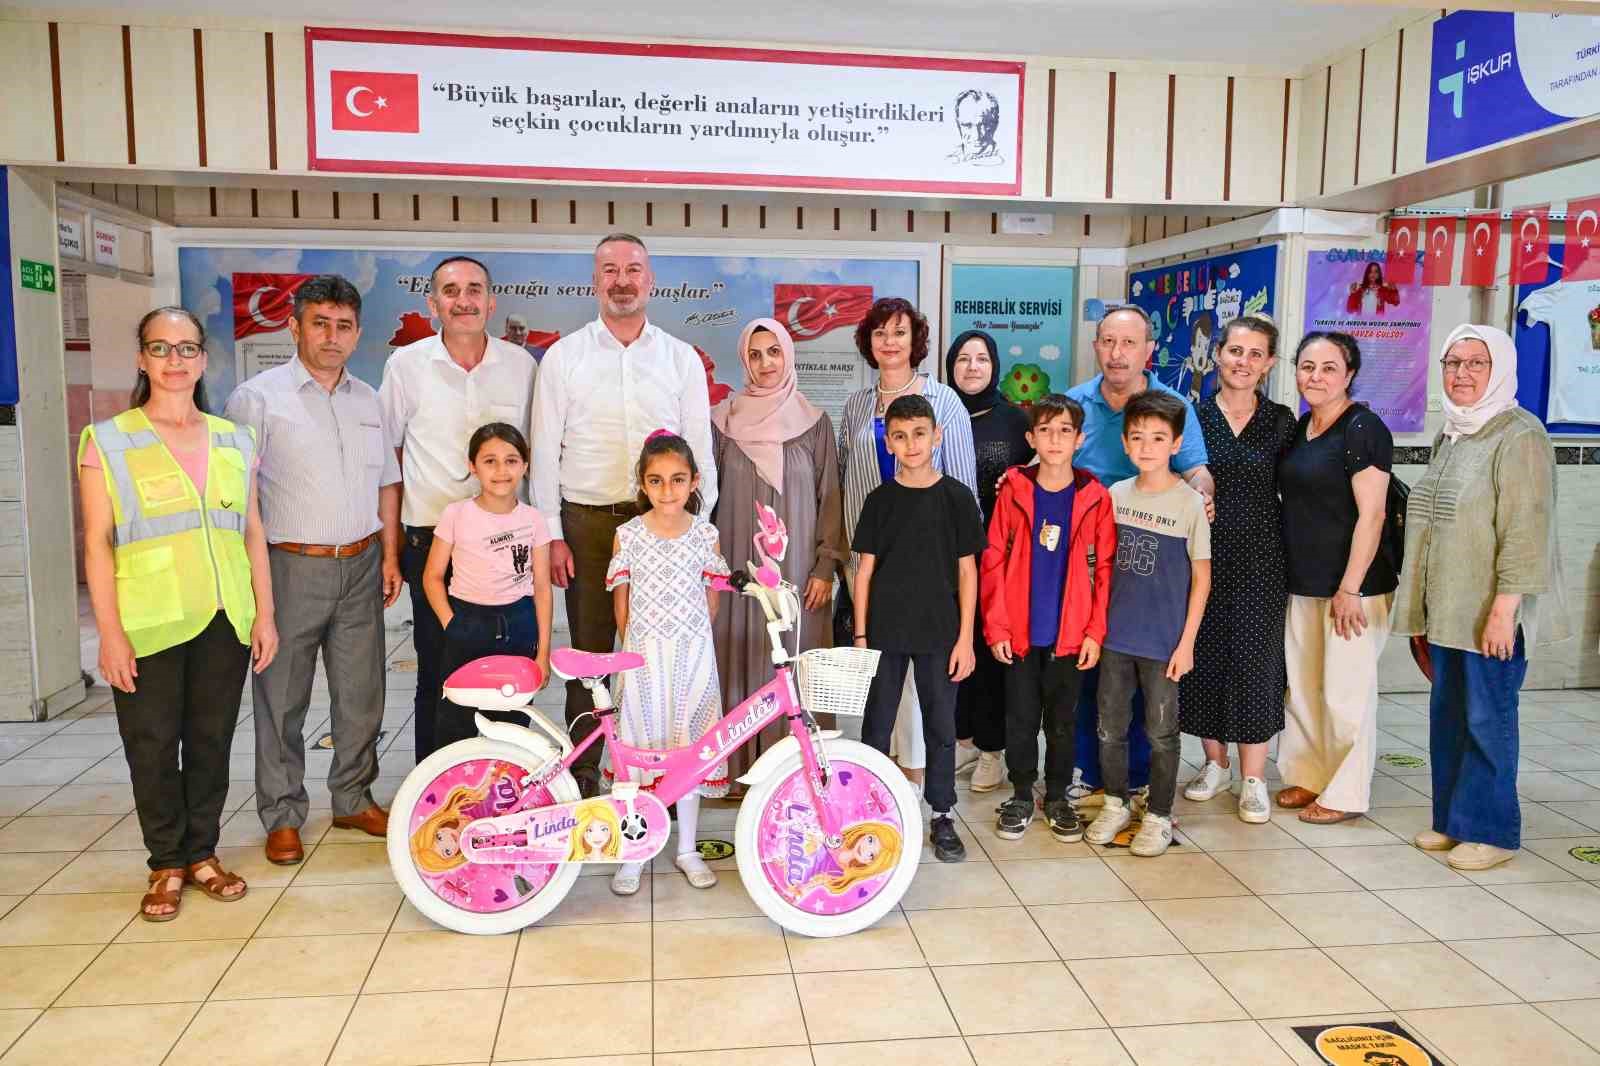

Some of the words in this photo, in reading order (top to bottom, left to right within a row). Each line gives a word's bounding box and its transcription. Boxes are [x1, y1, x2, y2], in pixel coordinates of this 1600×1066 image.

[1549, 67, 1597, 92] TARAFINDAN
[432, 82, 519, 107] “Büyük
[526, 87, 626, 111] başarılar,
[634, 91, 707, 115] değerli
[715, 97, 800, 117] anaların
[807, 101, 945, 124] yetiştirdikleri
[492, 111, 560, 134] seçkin
[568, 115, 682, 137] çocukların
[690, 120, 800, 144] yardımıyla
[807, 123, 889, 147] oluşur.”
[490, 281, 549, 298] ocuğu
[954, 298, 1016, 315] REHBERLİK
[1019, 299, 1062, 316] SERVİSİ
[1156, 515, 1176, 527] ONLY
[716, 694, 776, 750] Linda
[534, 816, 579, 840] Linda
